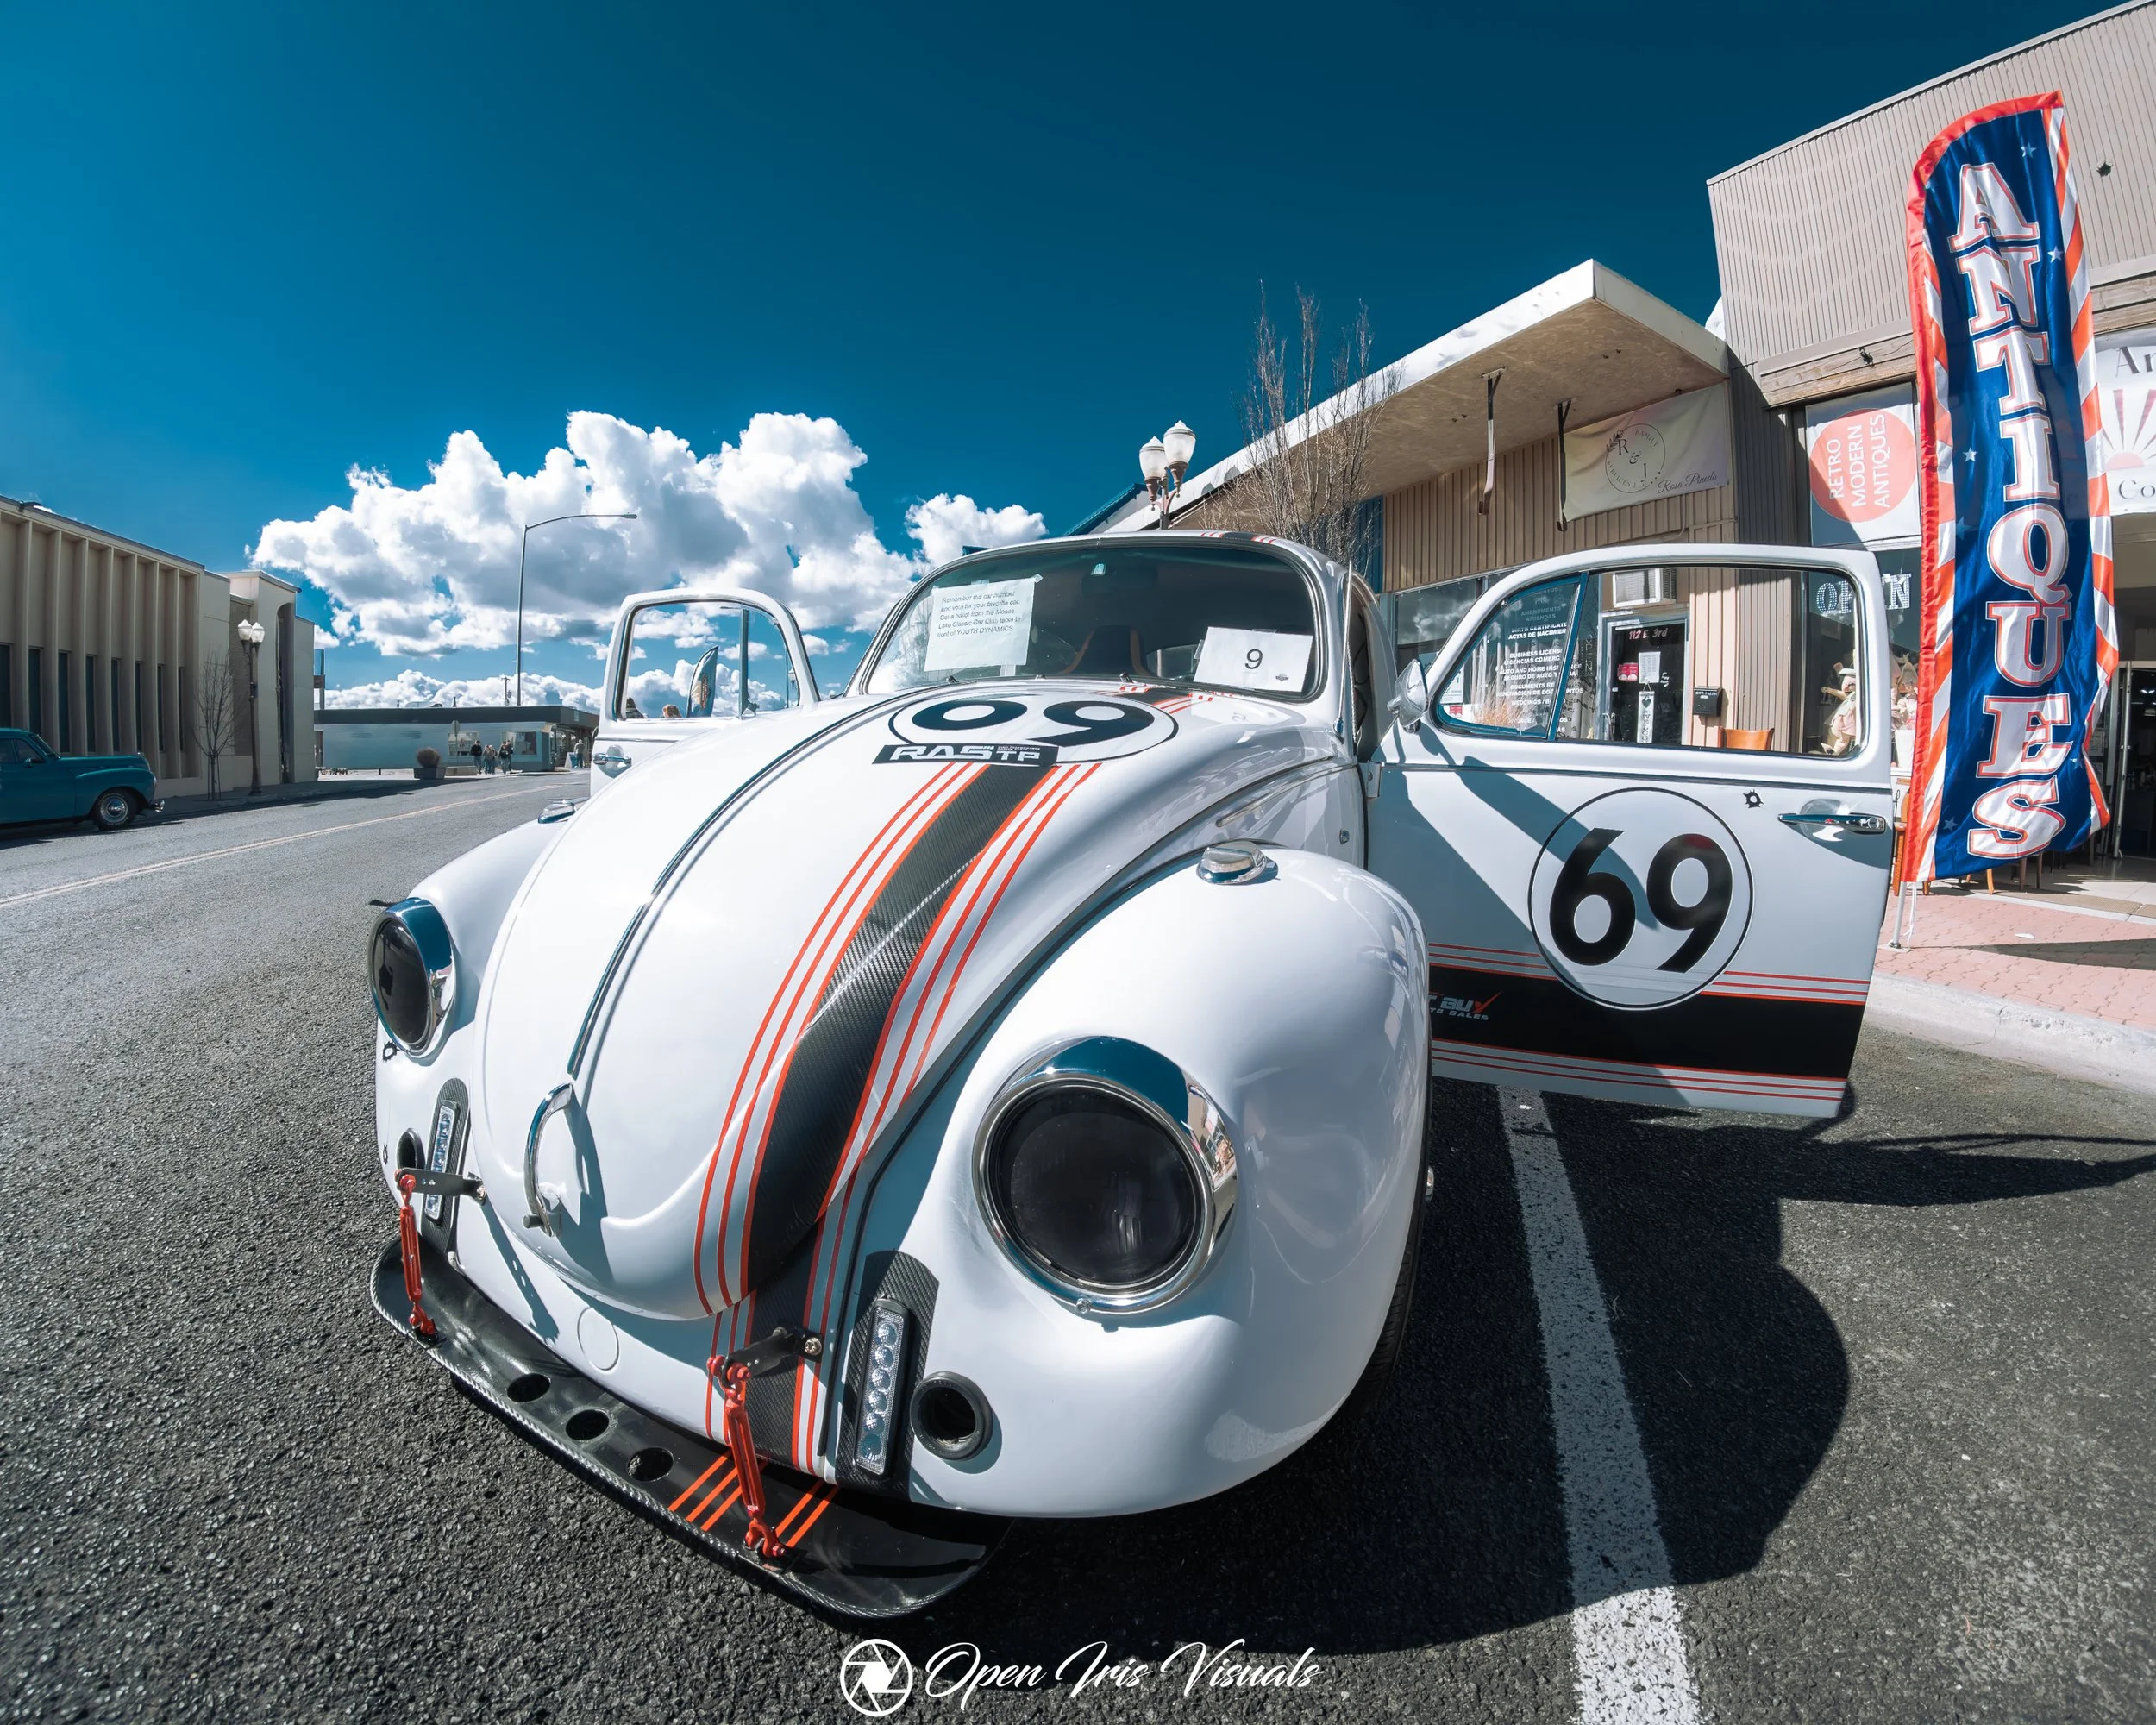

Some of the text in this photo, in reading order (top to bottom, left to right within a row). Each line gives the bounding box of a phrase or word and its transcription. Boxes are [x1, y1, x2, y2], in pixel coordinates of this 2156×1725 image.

[1617, 438, 1629, 456] R
[1640, 462, 1647, 483] J
[1827, 438, 1845, 499] RETRO
[1847, 423, 1867, 508] MODERN
[1870, 413, 1891, 508] ANTIQUES
[1947, 162, 2073, 859] ANTIQUES
[942, 594, 972, 603] Remember
[938, 621, 952, 630] Lake
[952, 619, 972, 628] Classic
[956, 627, 979, 636] YOUTH
[1629, 630, 1642, 640] 112
[1651, 628, 1669, 638] 3rd
[1244, 648, 1263, 670] 9
[1550, 827, 1733, 973] 69
[1449, 1010, 1489, 1021] SALES
